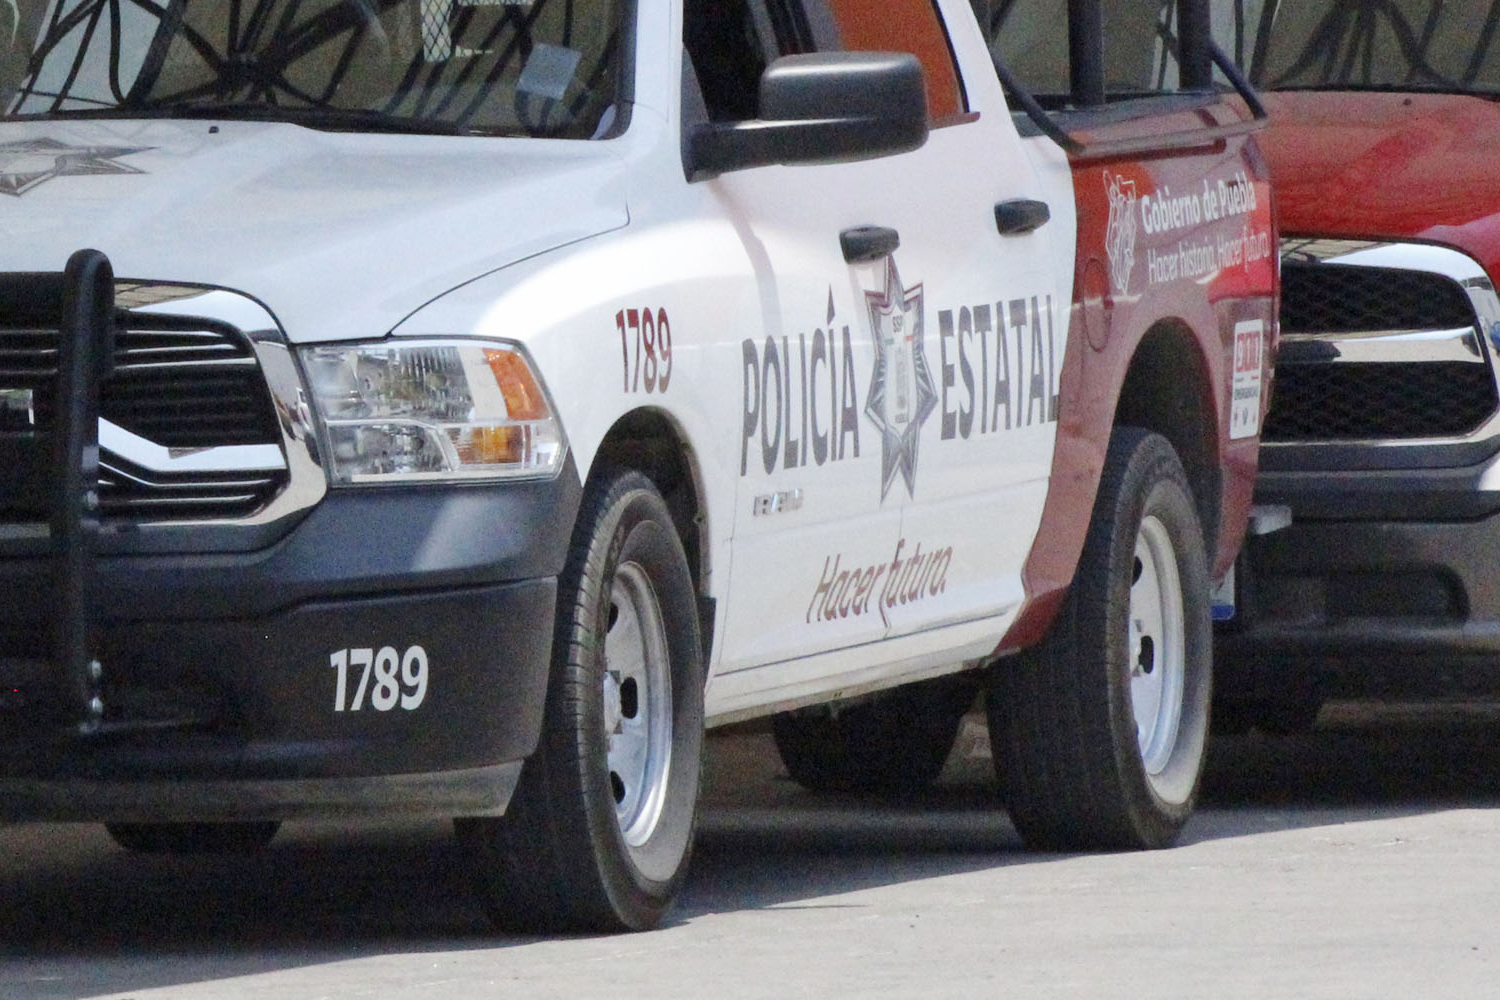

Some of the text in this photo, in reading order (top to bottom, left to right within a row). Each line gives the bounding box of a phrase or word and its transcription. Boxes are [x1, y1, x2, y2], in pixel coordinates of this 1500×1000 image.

[1141, 171, 1257, 234] Gobierno de Puebla
[1147, 248, 1179, 285] Hacer
[1217, 234, 1242, 269] Hacer
[615, 306, 673, 395] 1789
[740, 284, 1060, 477] POLICÍA ESTATAL
[805, 554, 887, 624] Hacer
[330, 645, 429, 712] 1789
